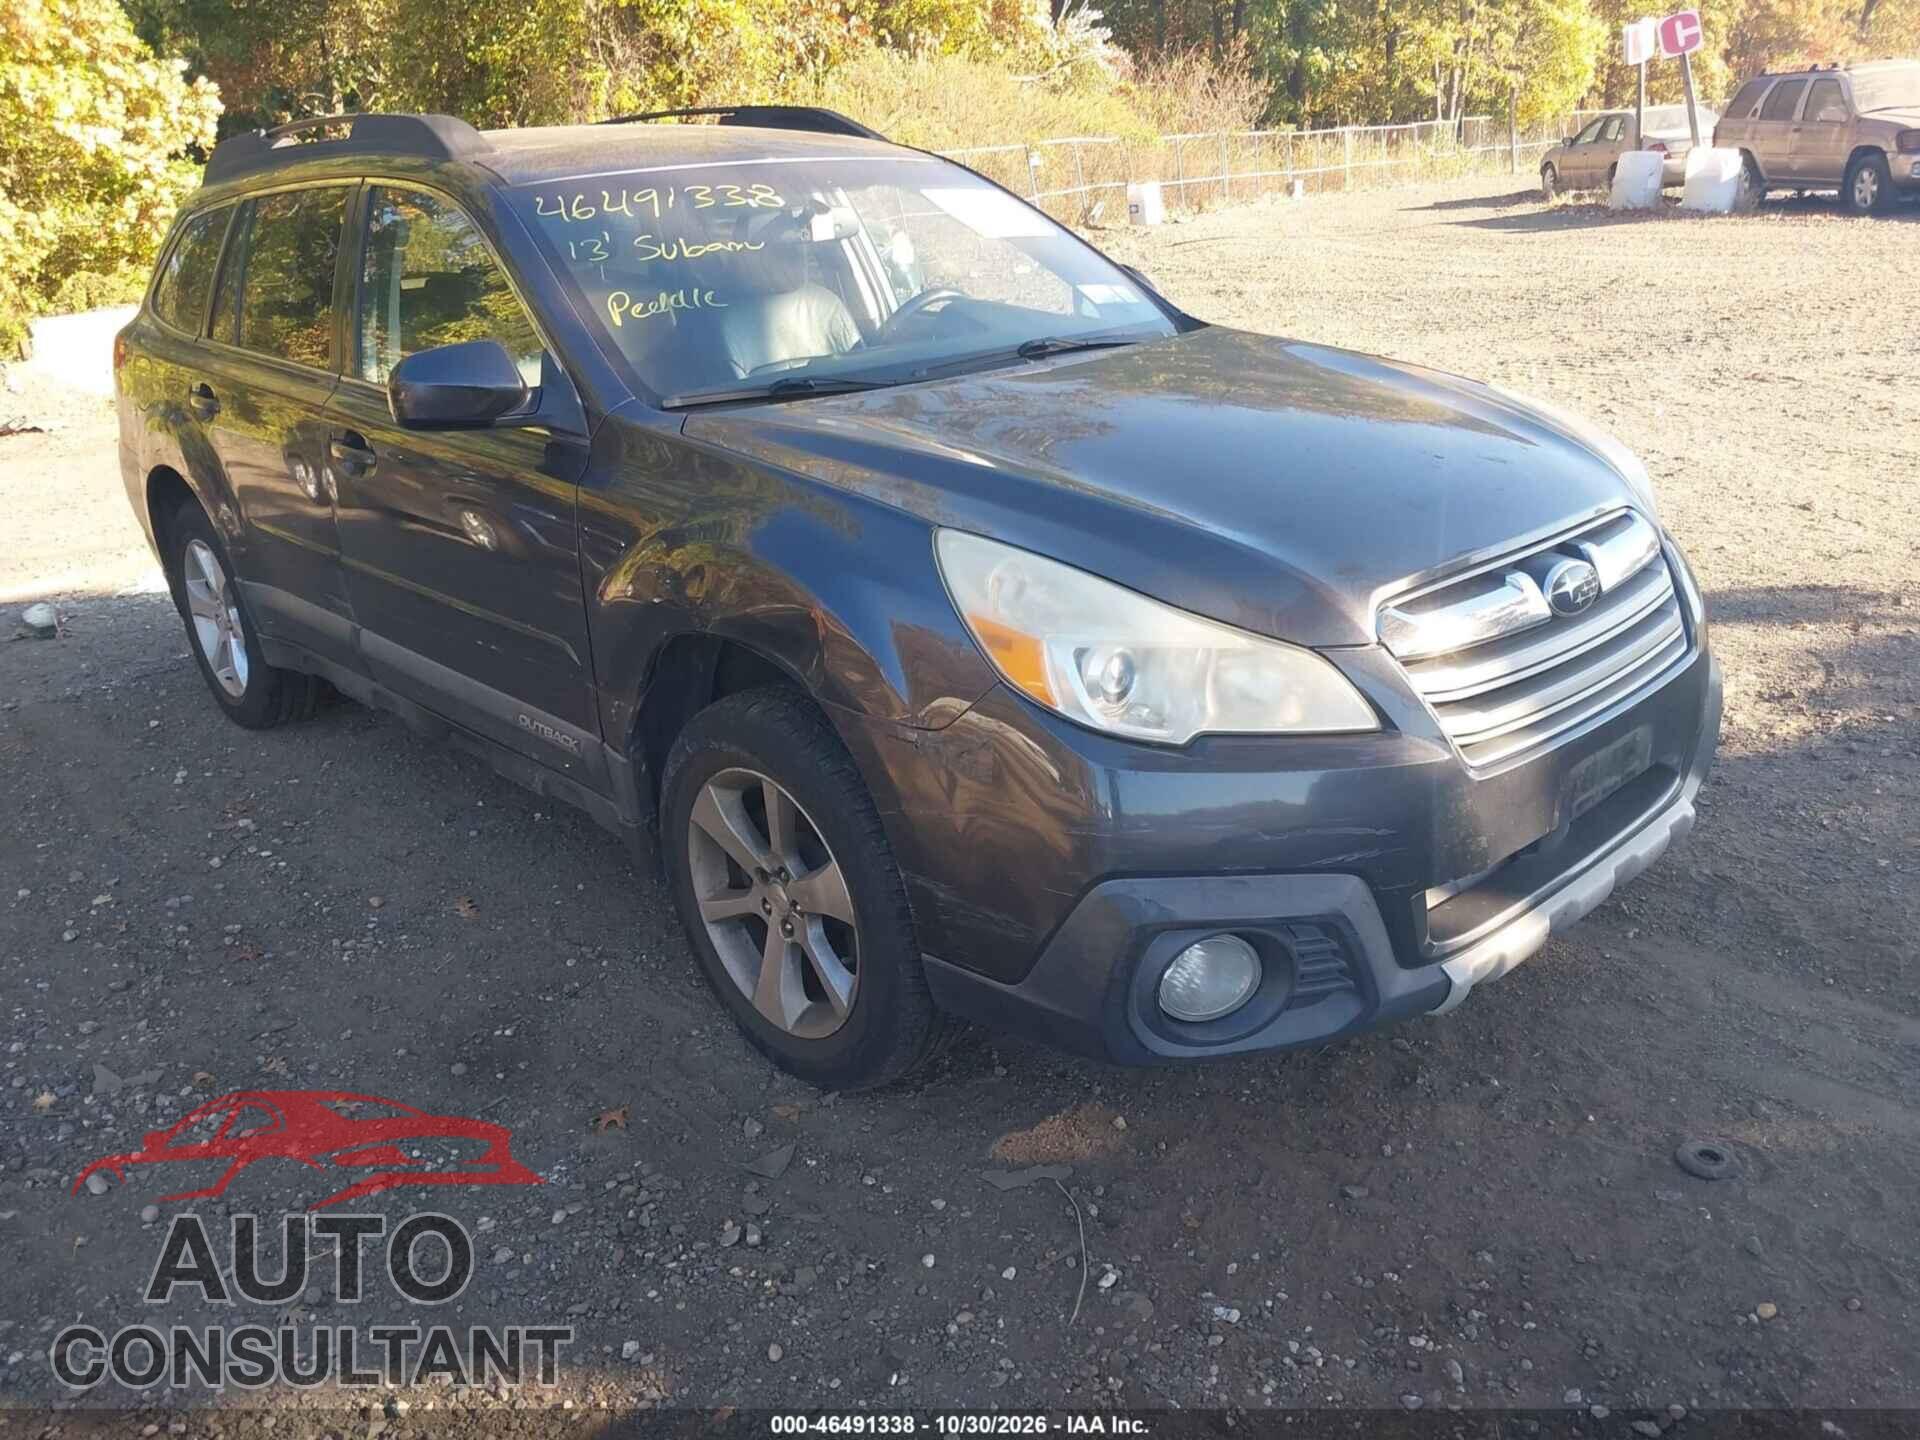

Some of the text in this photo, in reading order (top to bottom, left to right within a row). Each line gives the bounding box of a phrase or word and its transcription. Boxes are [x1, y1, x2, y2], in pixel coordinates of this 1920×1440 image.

[1661, 13, 1700, 54] C
[535, 184, 786, 223] 46491338
[518, 714, 579, 753] OUTBACK
